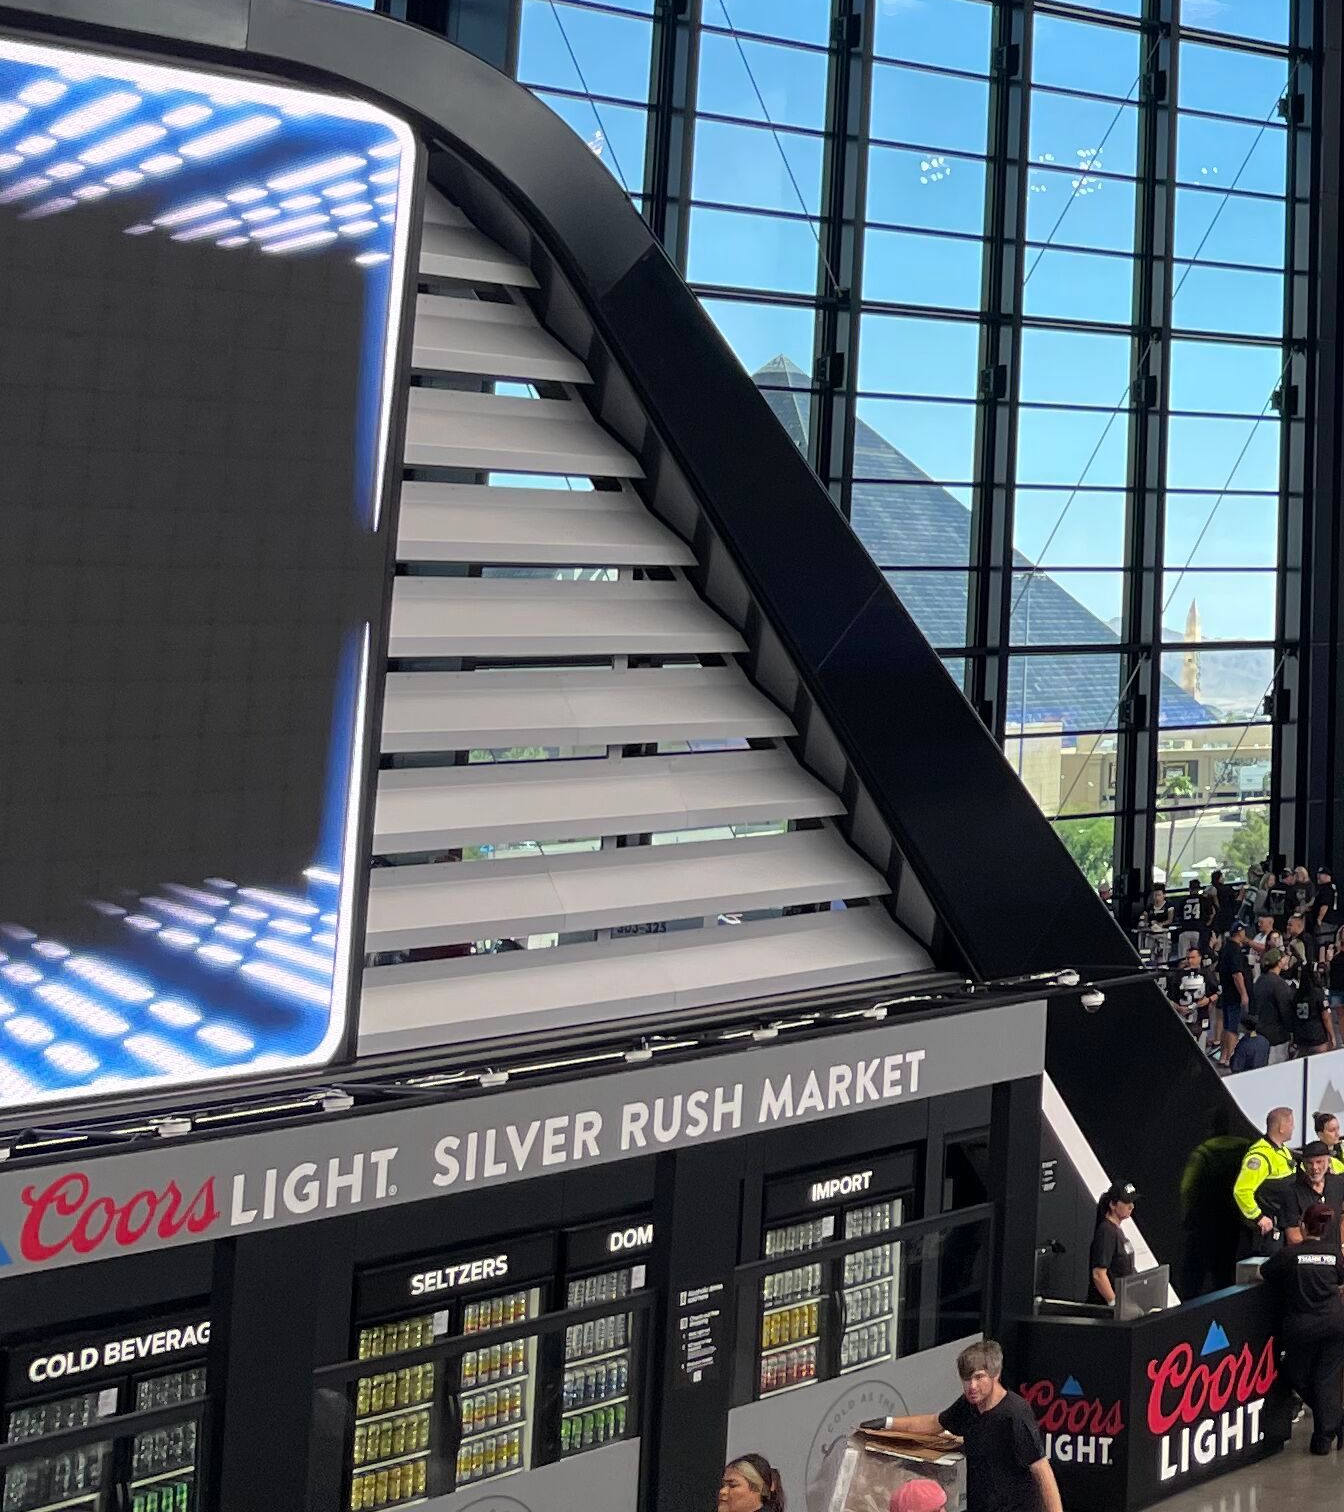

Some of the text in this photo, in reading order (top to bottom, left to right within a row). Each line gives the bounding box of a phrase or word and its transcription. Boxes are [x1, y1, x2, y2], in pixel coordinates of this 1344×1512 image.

[21, 1173, 220, 1263] Coors
[432, 1109, 604, 1188] SILVER
[620, 1083, 744, 1151] RUSH
[758, 1049, 927, 1124] MARKET
[811, 1170, 873, 1201] IMPORT
[609, 1224, 654, 1251] DOM
[410, 1254, 509, 1296] SELTZERS
[28, 1321, 211, 1383] COLD BEVERAG
[1147, 1336, 1279, 1435] Coors
[1045, 1432, 1113, 1465] IGHT
